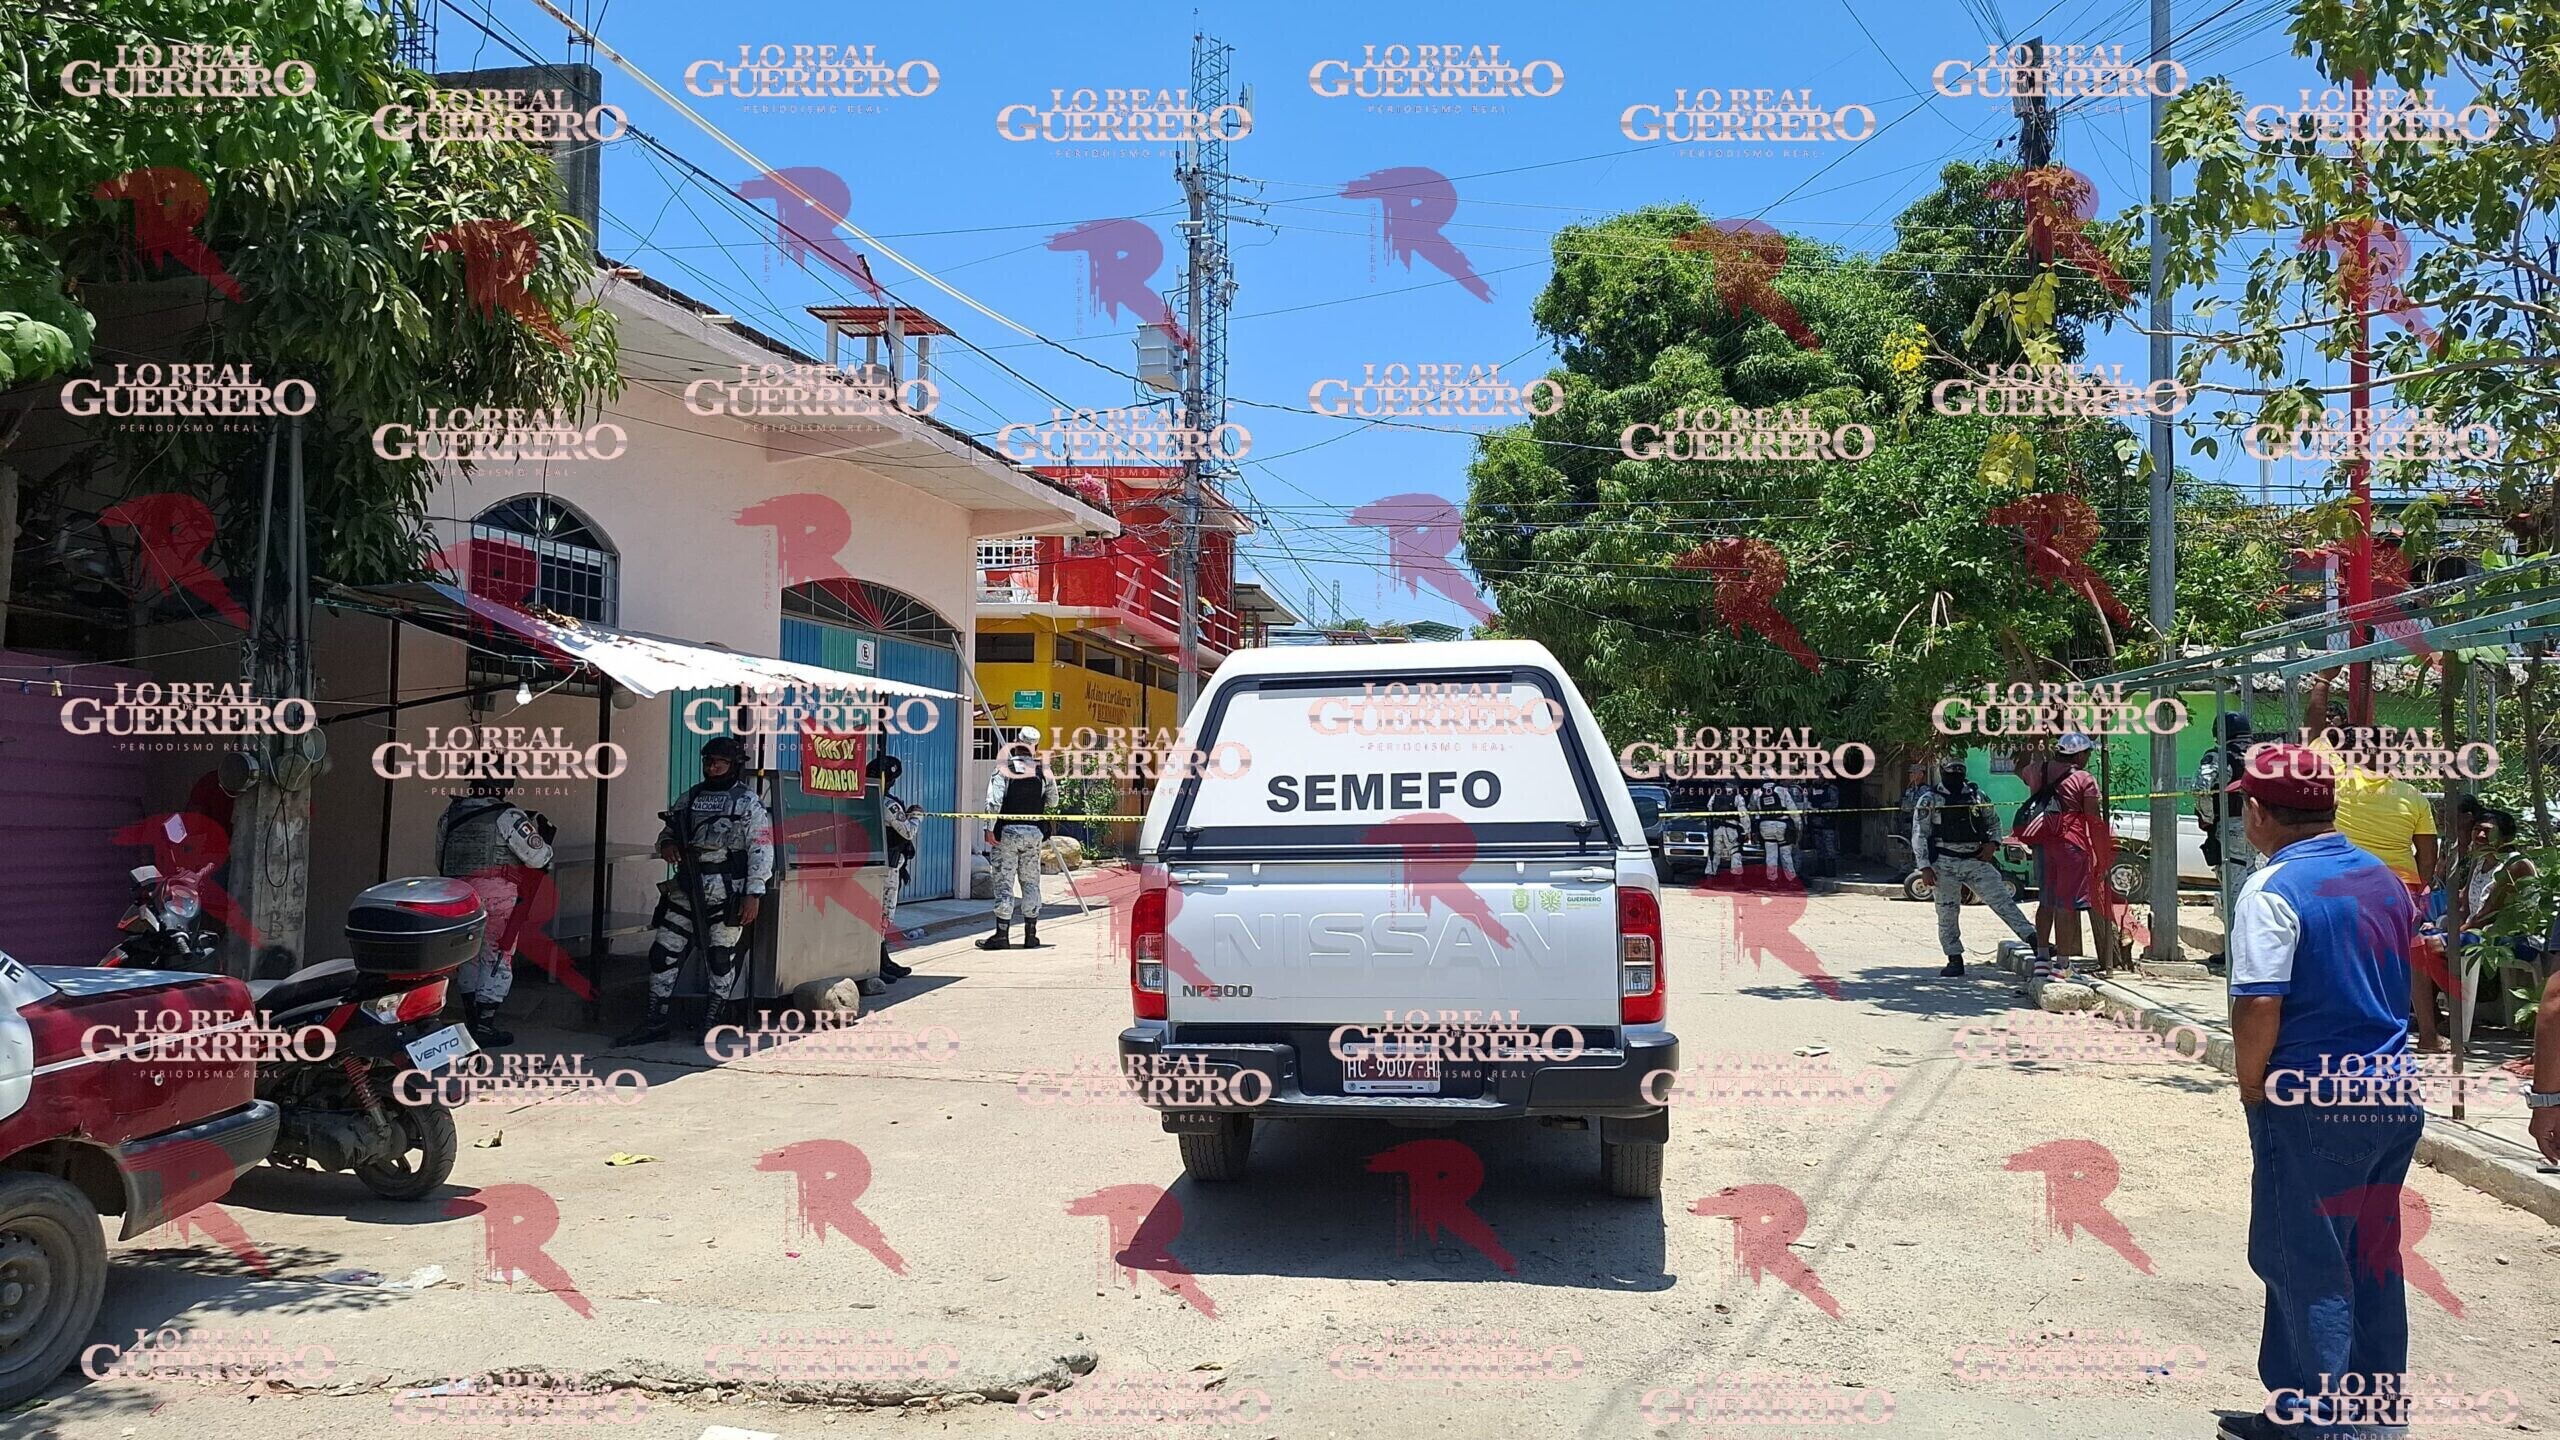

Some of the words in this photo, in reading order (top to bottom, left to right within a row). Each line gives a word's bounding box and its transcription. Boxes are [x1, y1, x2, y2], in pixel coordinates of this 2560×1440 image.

[1266, 770, 1501, 813] SEMEFO
[1213, 913, 1566, 968] NISSAN
[1182, 984, 1253, 998] NP300
[415, 1037, 459, 1063] VENTO
[1347, 1058, 1436, 1078] HC-9007-H
